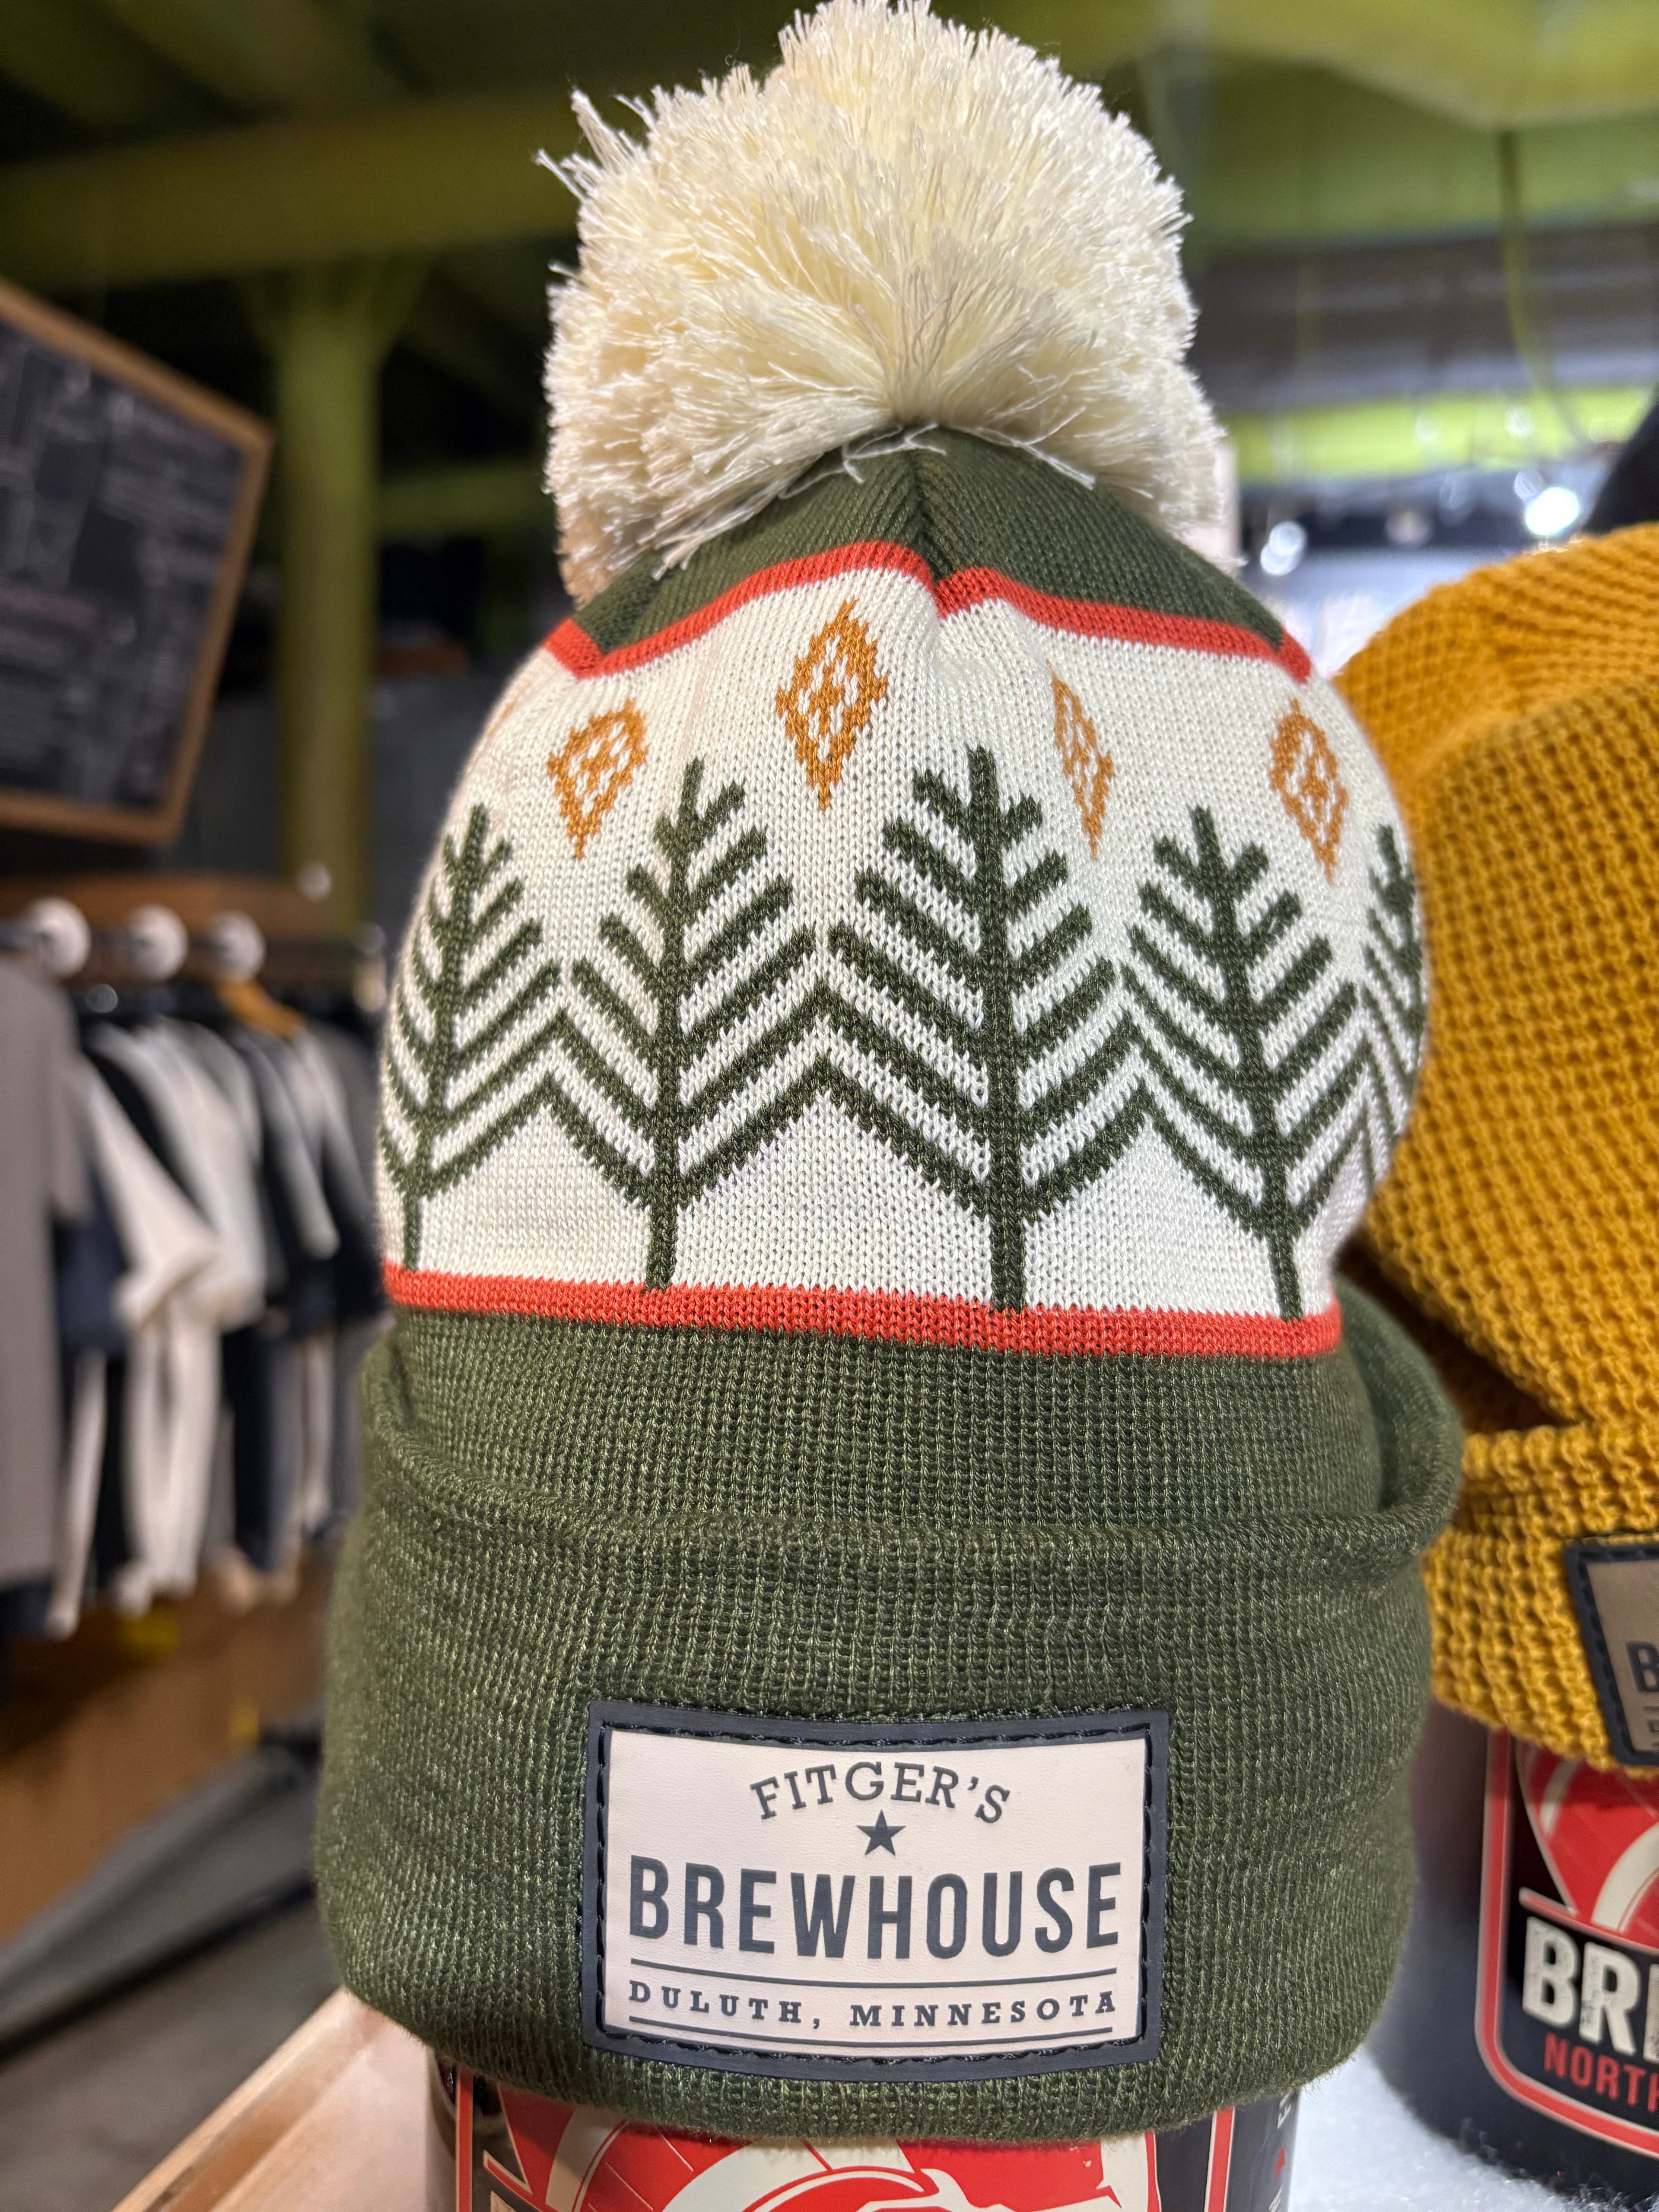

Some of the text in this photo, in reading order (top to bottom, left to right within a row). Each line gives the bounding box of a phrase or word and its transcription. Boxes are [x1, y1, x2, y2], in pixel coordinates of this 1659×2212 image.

[751, 1761, 1010, 1824] FITGER'S
[630, 1855, 1121, 1959] BREWHOUSE
[629, 1980, 1115, 2029] DULUTH, MINNESOTA
